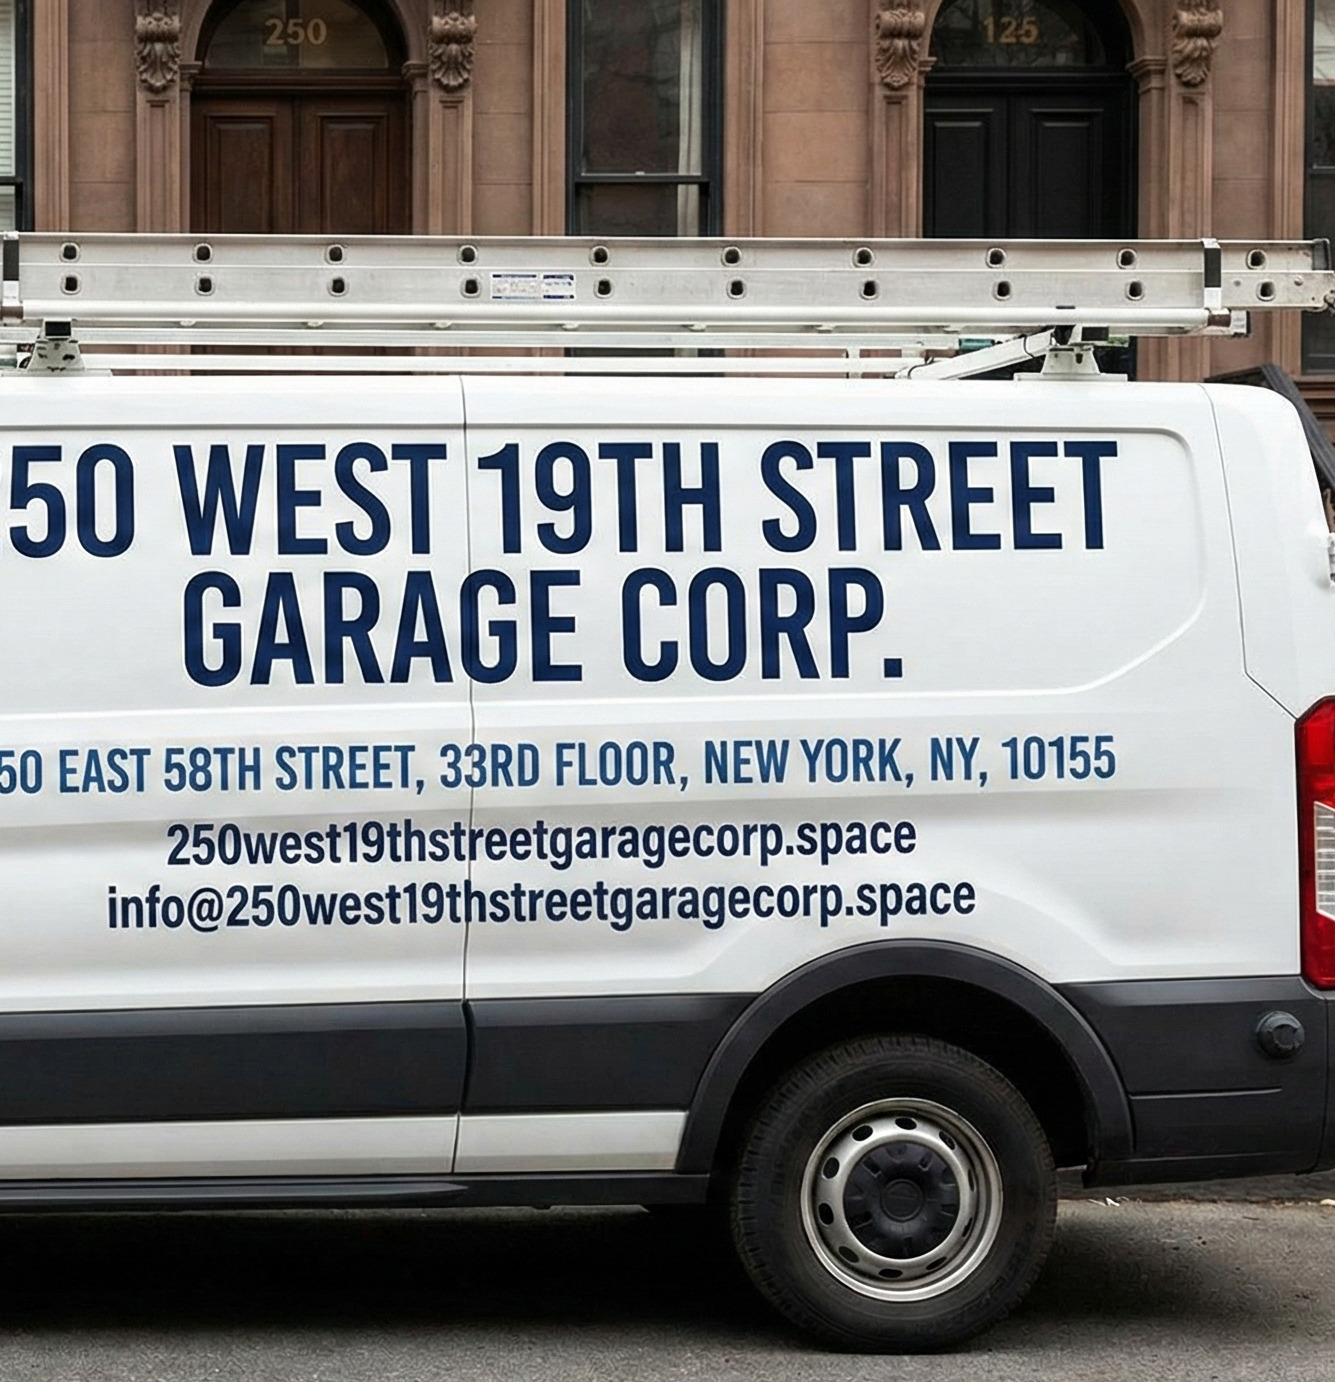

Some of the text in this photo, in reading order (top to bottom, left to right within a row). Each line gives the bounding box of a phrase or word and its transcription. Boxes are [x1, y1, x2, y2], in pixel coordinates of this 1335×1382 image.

[264, 18, 327, 45] 250
[983, 16, 1039, 44] 125
[172, 442, 448, 556] WEST
[477, 442, 722, 555] 19TH
[760, 440, 1118, 553] STREET
[183, 567, 903, 687] GARAGE CORP.
[61, 748, 151, 794] EAST
[164, 746, 261, 792] 58TH
[275, 744, 425, 796] STREET,
[439, 742, 540, 789] 33RD
[555, 740, 688, 792] FLOOR,
[704, 739, 790, 784] NEW
[802, 737, 914, 789] YORK,
[930, 737, 988, 788] NY,
[1001, 735, 1116, 780] 10155
[166, 818, 917, 871] 250west19thstreetgaragecorp.space
[108, 879, 976, 932] info@250west19thstreetgaragecorp.space
